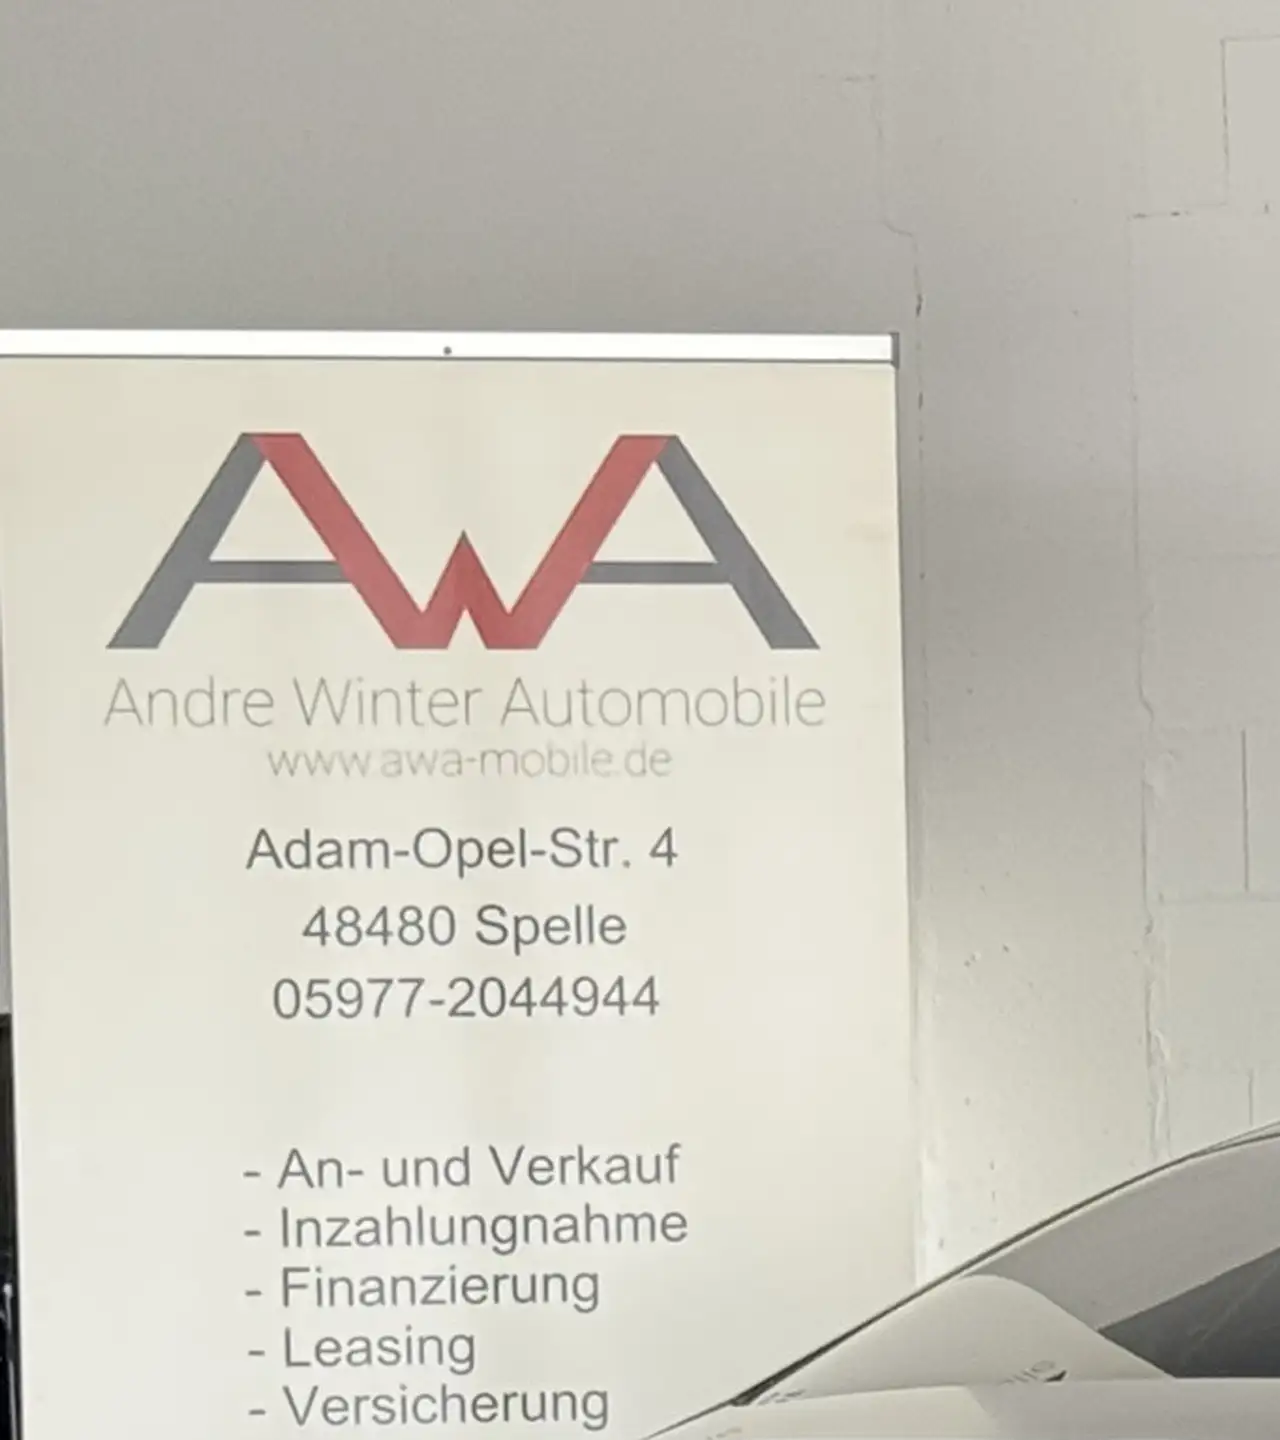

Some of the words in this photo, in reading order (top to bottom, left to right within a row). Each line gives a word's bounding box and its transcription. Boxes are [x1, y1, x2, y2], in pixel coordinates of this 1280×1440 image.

[105, 432, 821, 650] AWA
[104, 675, 275, 729] Andre
[292, 675, 484, 728] Winter
[500, 675, 828, 729] Automobile
[266, 739, 674, 779] www.awa-mobile.de
[245, 826, 632, 881] Adam-Opel-Str.
[649, 827, 679, 869] 4
[301, 904, 457, 948] 48480
[475, 903, 628, 957] Spelle
[272, 974, 661, 1021] 05977-2044944
[276, 1147, 365, 1190] An-
[382, 1144, 471, 1189] und
[487, 1141, 682, 1187] Verkauf
[280, 1201, 688, 1257] Inzahlungnahme
[281, 1263, 599, 1314] Finanzierung
[283, 1323, 475, 1376] Leasing
[281, 1382, 609, 1432] Versicherung
